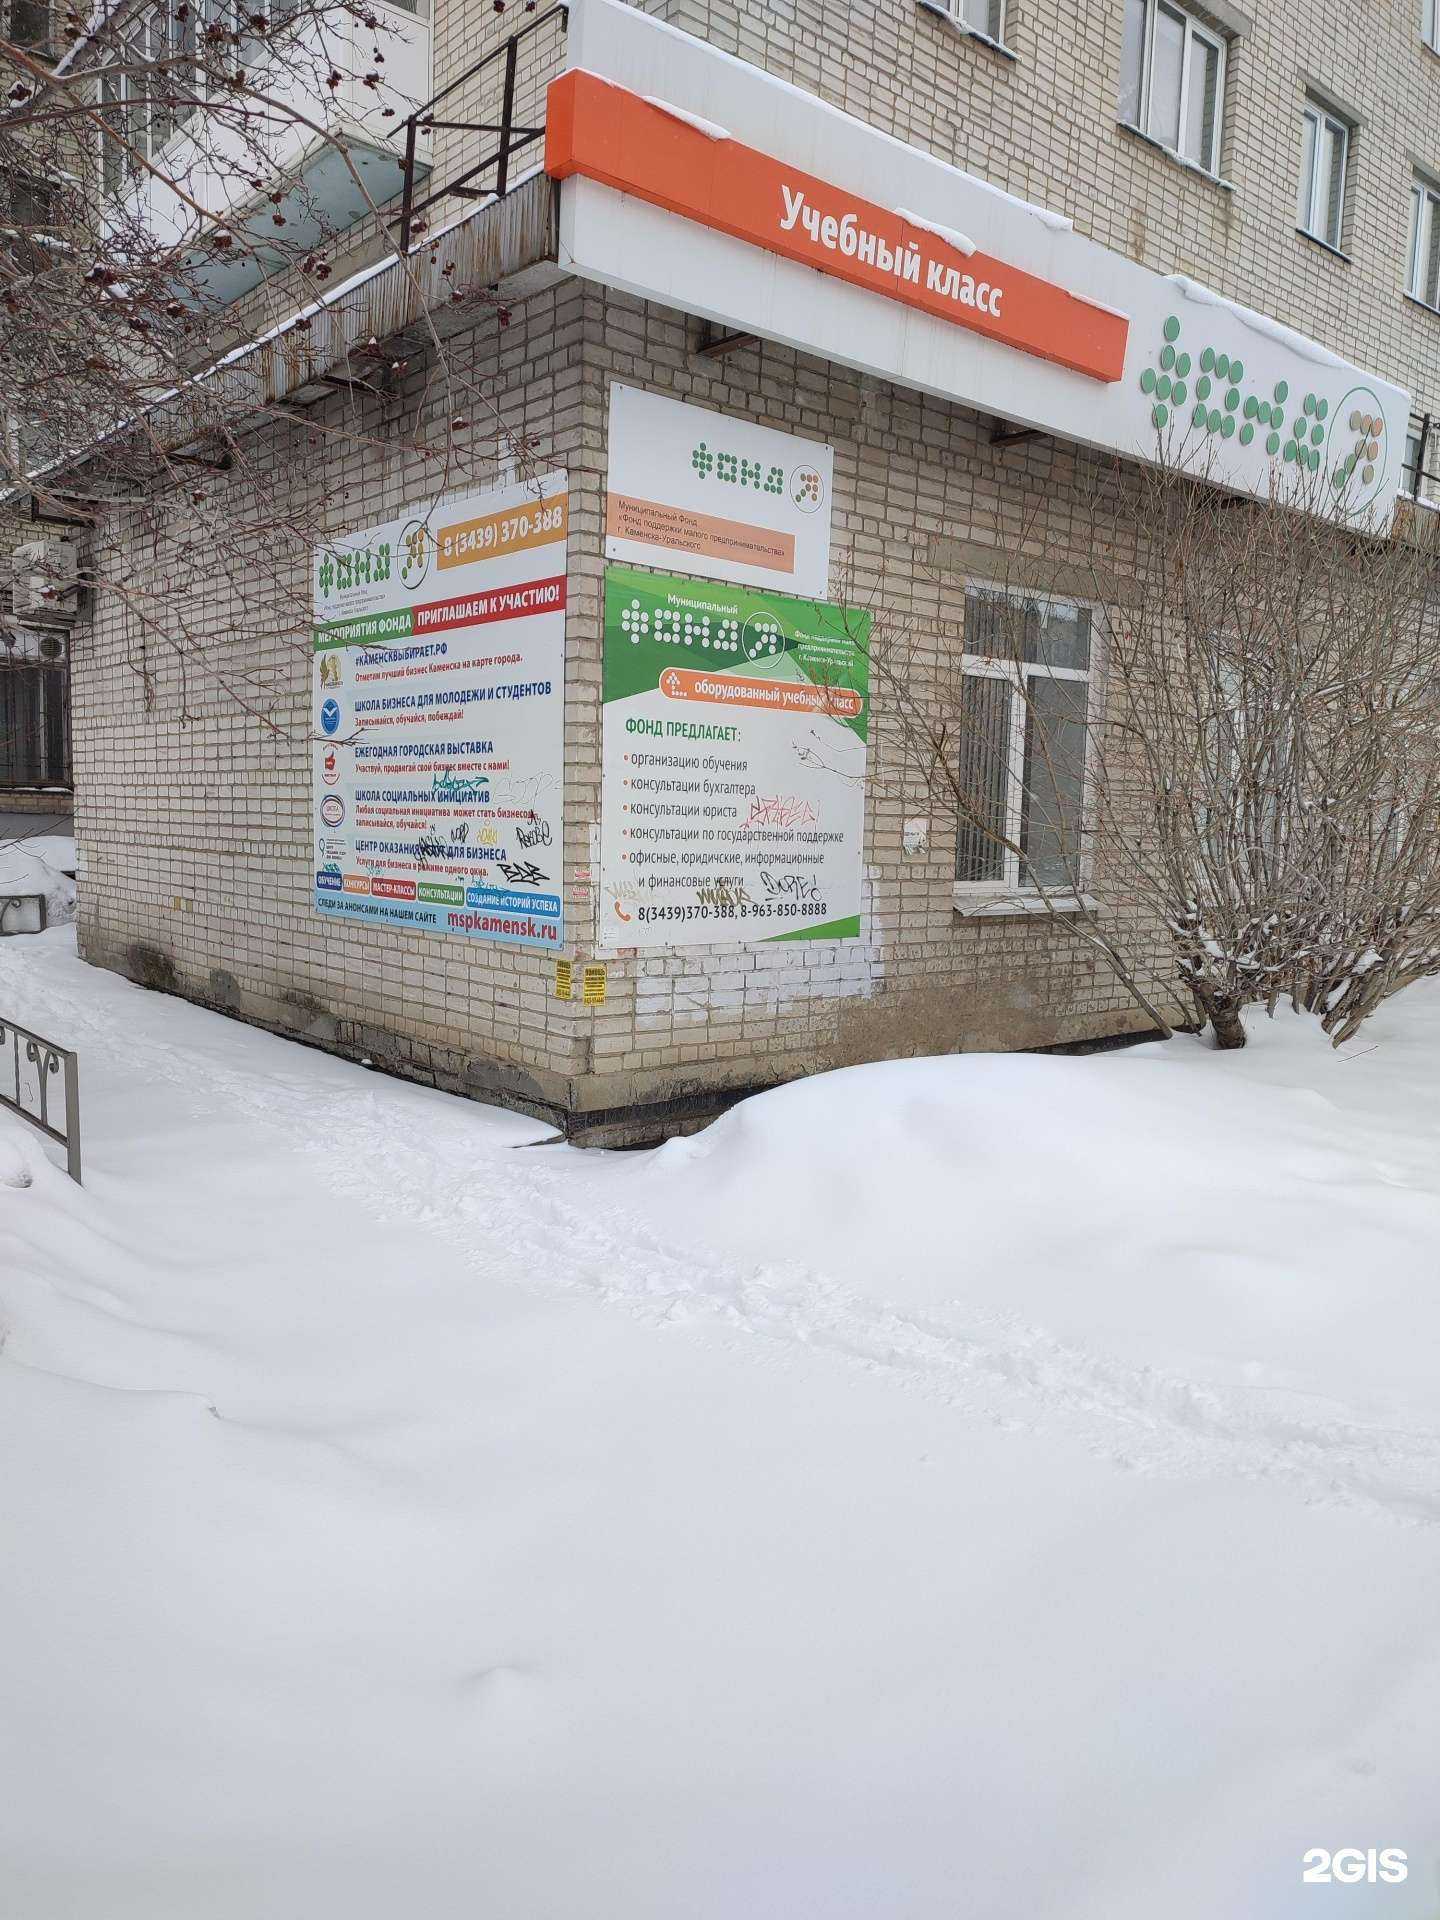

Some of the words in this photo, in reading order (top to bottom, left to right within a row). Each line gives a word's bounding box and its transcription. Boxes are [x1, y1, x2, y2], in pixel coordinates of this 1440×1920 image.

[780, 184, 921, 284] Учебный
[926, 259, 1003, 318] класс
[618, 500, 678, 521] Муниципальный
[679, 514, 698, 527] Фонд
[444, 537, 452, 557] 8
[455, 523, 498, 559] (3439)
[501, 505, 563, 542] 370-388
[624, 526, 701, 550] Каменска-Уральского
[643, 517, 683, 534] поддержки
[683, 528, 709, 541] малого
[417, 605, 489, 627] ПРИГЛАШАЕМ
[489, 601, 497, 614] К
[498, 584, 560, 612] УЧАСТИЮ!
[667, 593, 739, 615] Муниципальный
[317, 622, 377, 643] МЕРОПРИЯТИЯ
[378, 614, 412, 633] ФОНДА
[382, 668, 405, 681] лучший
[405, 665, 428, 676] бизнес
[428, 661, 461, 674] Каменска
[462, 660, 471, 669] на
[472, 658, 493, 669] карте
[494, 653, 524, 667] города.
[354, 699, 381, 712] ШКОЛА
[382, 695, 416, 710] БИЗНЕСА
[417, 693, 434, 709] ДЛЯ
[435, 688, 486, 705] МОЛОДЕЖИ
[487, 687, 494, 700] И
[495, 681, 552, 702] СТУДЕНТОВ
[694, 679, 780, 702] оборудованный
[395, 713, 427, 726] обучайся,
[428, 709, 464, 722] побеждай!
[625, 717, 663, 737] ФОНД
[666, 721, 742, 743] ПРЕДЛАГАЕТ:
[354, 745, 398, 759] ЕЖЕГОДНАЯ
[399, 743, 446, 759] ГОРОДСКАЯ
[447, 741, 494, 755] ВЫСТАВКА
[384, 762, 417, 775] продвигай
[417, 761, 433, 772] свой
[433, 761, 457, 772] бизнес
[457, 762, 482, 771] вместе
[488, 759, 510, 770] нами!
[631, 752, 700, 772] организацию
[702, 755, 748, 773] обучения
[355, 790, 381, 801] ШКОЛА
[382, 790, 436, 804] СОЦИАЛЬНЫХ
[437, 790, 490, 805] ИНИЦИАТИВ
[631, 778, 700, 796] консультации
[703, 779, 756, 798] бухгалтера
[355, 804, 375, 815] Любая
[375, 806, 411, 816] социальная
[411, 807, 451, 818] инициатива
[453, 809, 475, 818] может
[476, 809, 496, 818] стать
[630, 803, 700, 821] консультации
[703, 805, 737, 820] юриста
[396, 818, 427, 831] обучайся!
[630, 828, 700, 845] консультации
[702, 829, 714, 840] по
[717, 828, 794, 845] государственной
[796, 831, 844, 845] поддержке
[355, 840, 377, 853] ЦЕНТР
[379, 842, 420, 855] ОКАЗАНИЯ
[447, 846, 465, 860] ДЛЯ
[466, 847, 507, 862] БИЗНЕСА
[629, 848, 679, 867] офисные,
[744, 851, 825, 867] информационные
[355, 855, 375, 867] Услуги
[375, 859, 387, 868] для
[387, 859, 412, 870] бизнеса
[445, 864, 469, 875] одного
[469, 867, 489, 877] окна.
[638, 877, 646, 888] и
[647, 873, 711, 890] финансовые
[713, 875, 744, 890] услуги
[373, 882, 416, 896] МАСТЕР-КЛАССЫ
[418, 886, 463, 903] КОНСУЛЬТАЦИИ
[467, 891, 500, 907] СОЗДАНИЕ
[500, 895, 531, 909] ИСТОРИЙ
[531, 899, 558, 912] УСПЕХА
[317, 897, 336, 909] СЛЕДИ
[336, 900, 344, 910] ЗА
[344, 902, 379, 916] АНОНСАМИ
[379, 906, 389, 917] НА
[389, 907, 414, 920] НАШЕМ
[414, 909, 437, 924] САЙТЕ
[740, 902, 827, 917] 8-963-850-8888
[447, 911, 557, 941] mspkamensk.ru
